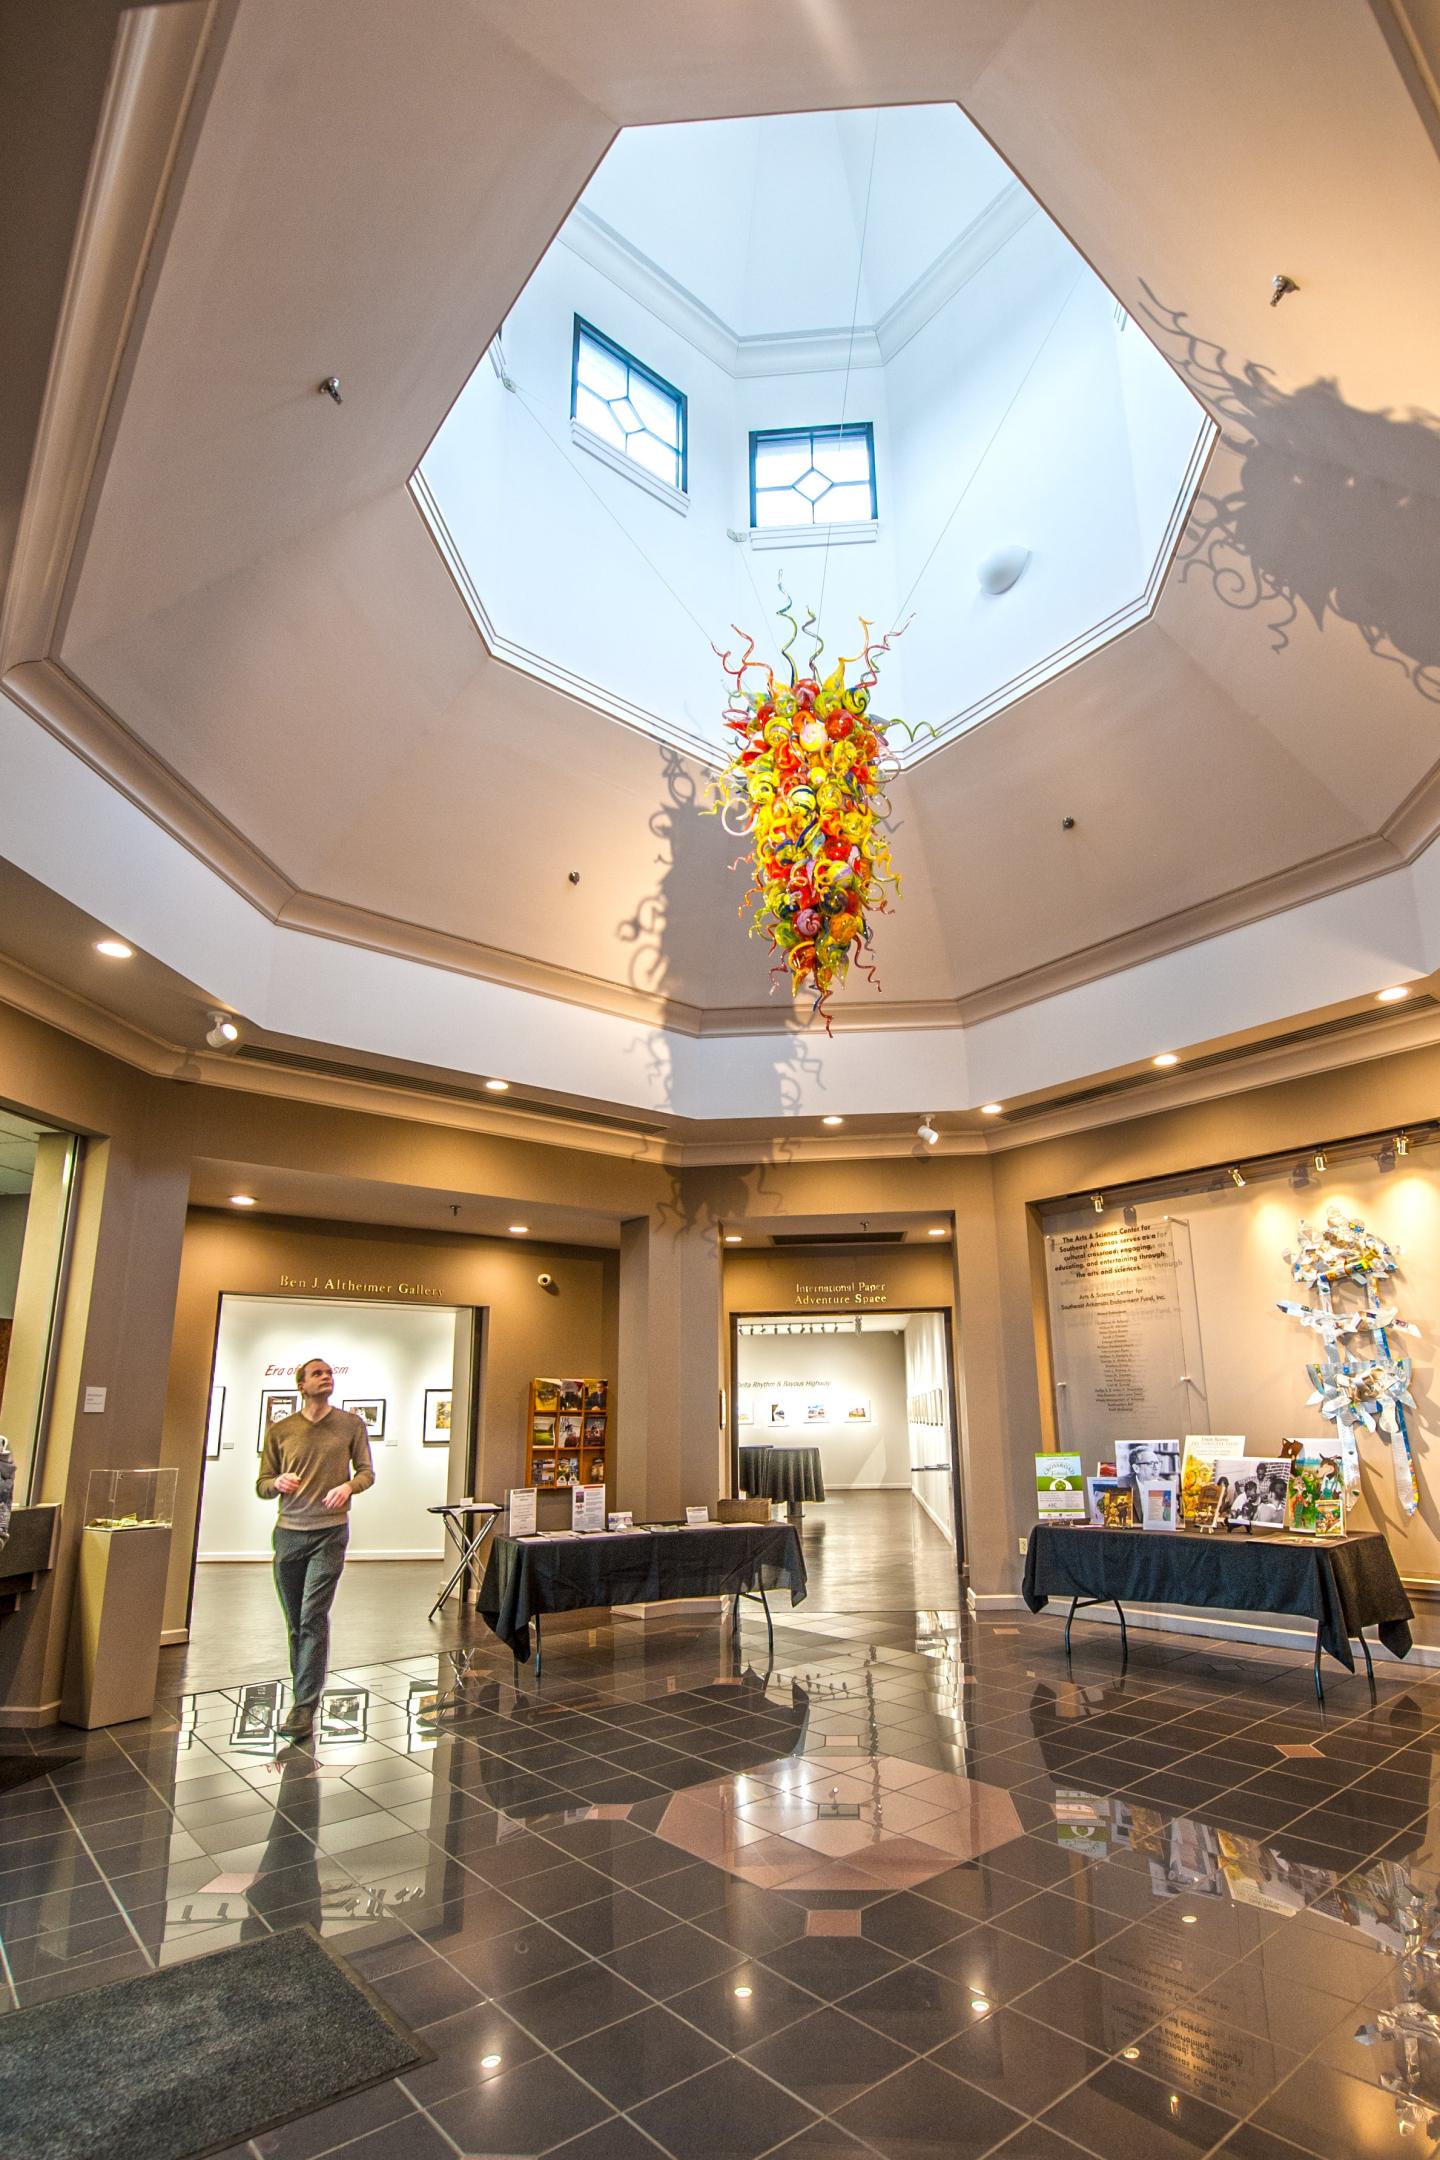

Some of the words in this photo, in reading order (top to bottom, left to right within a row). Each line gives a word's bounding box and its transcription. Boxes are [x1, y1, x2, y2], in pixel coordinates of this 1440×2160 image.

[1062, 1236, 1074, 1244] The
[1075, 1234, 1088, 1242] Arts
[1095, 1230, 1118, 1239] Science
[1120, 1226, 1140, 1235] Center
[1141, 1224, 1151, 1232] for
[1059, 1243, 1088, 1253] Southeast
[1089, 1239, 1119, 1249] Arkansas
[1120, 1236, 1141, 1244] serves
[1064, 1251, 1086, 1261] cultural
[1120, 1243, 1153, 1255] engaging,
[1054, 1262, 1085, 1272] educating,
[1100, 1255, 1138, 1266] entertaining
[1139, 1250, 1165, 1261] through
[1087, 1269, 1099, 1277] arts
[1100, 1267, 1113, 1275] and
[1114, 1265, 1142, 1274] sciences.
[280, 1274, 306, 1288] Ben
[325, 1278, 393, 1294] Altheimer
[398, 1283, 444, 1299] Gallery
[796, 1282, 855, 1293] International
[858, 1281, 886, 1293] Paper
[794, 1295, 850, 1305] Adventure
[854, 1293, 887, 1304] Space
[1060, 1302, 1085, 1311] Southeast
[1085, 1300, 1109, 1308] Arkansas
[1109, 1297, 1139, 1305] Endowment
[265, 1364, 284, 1376] Era
